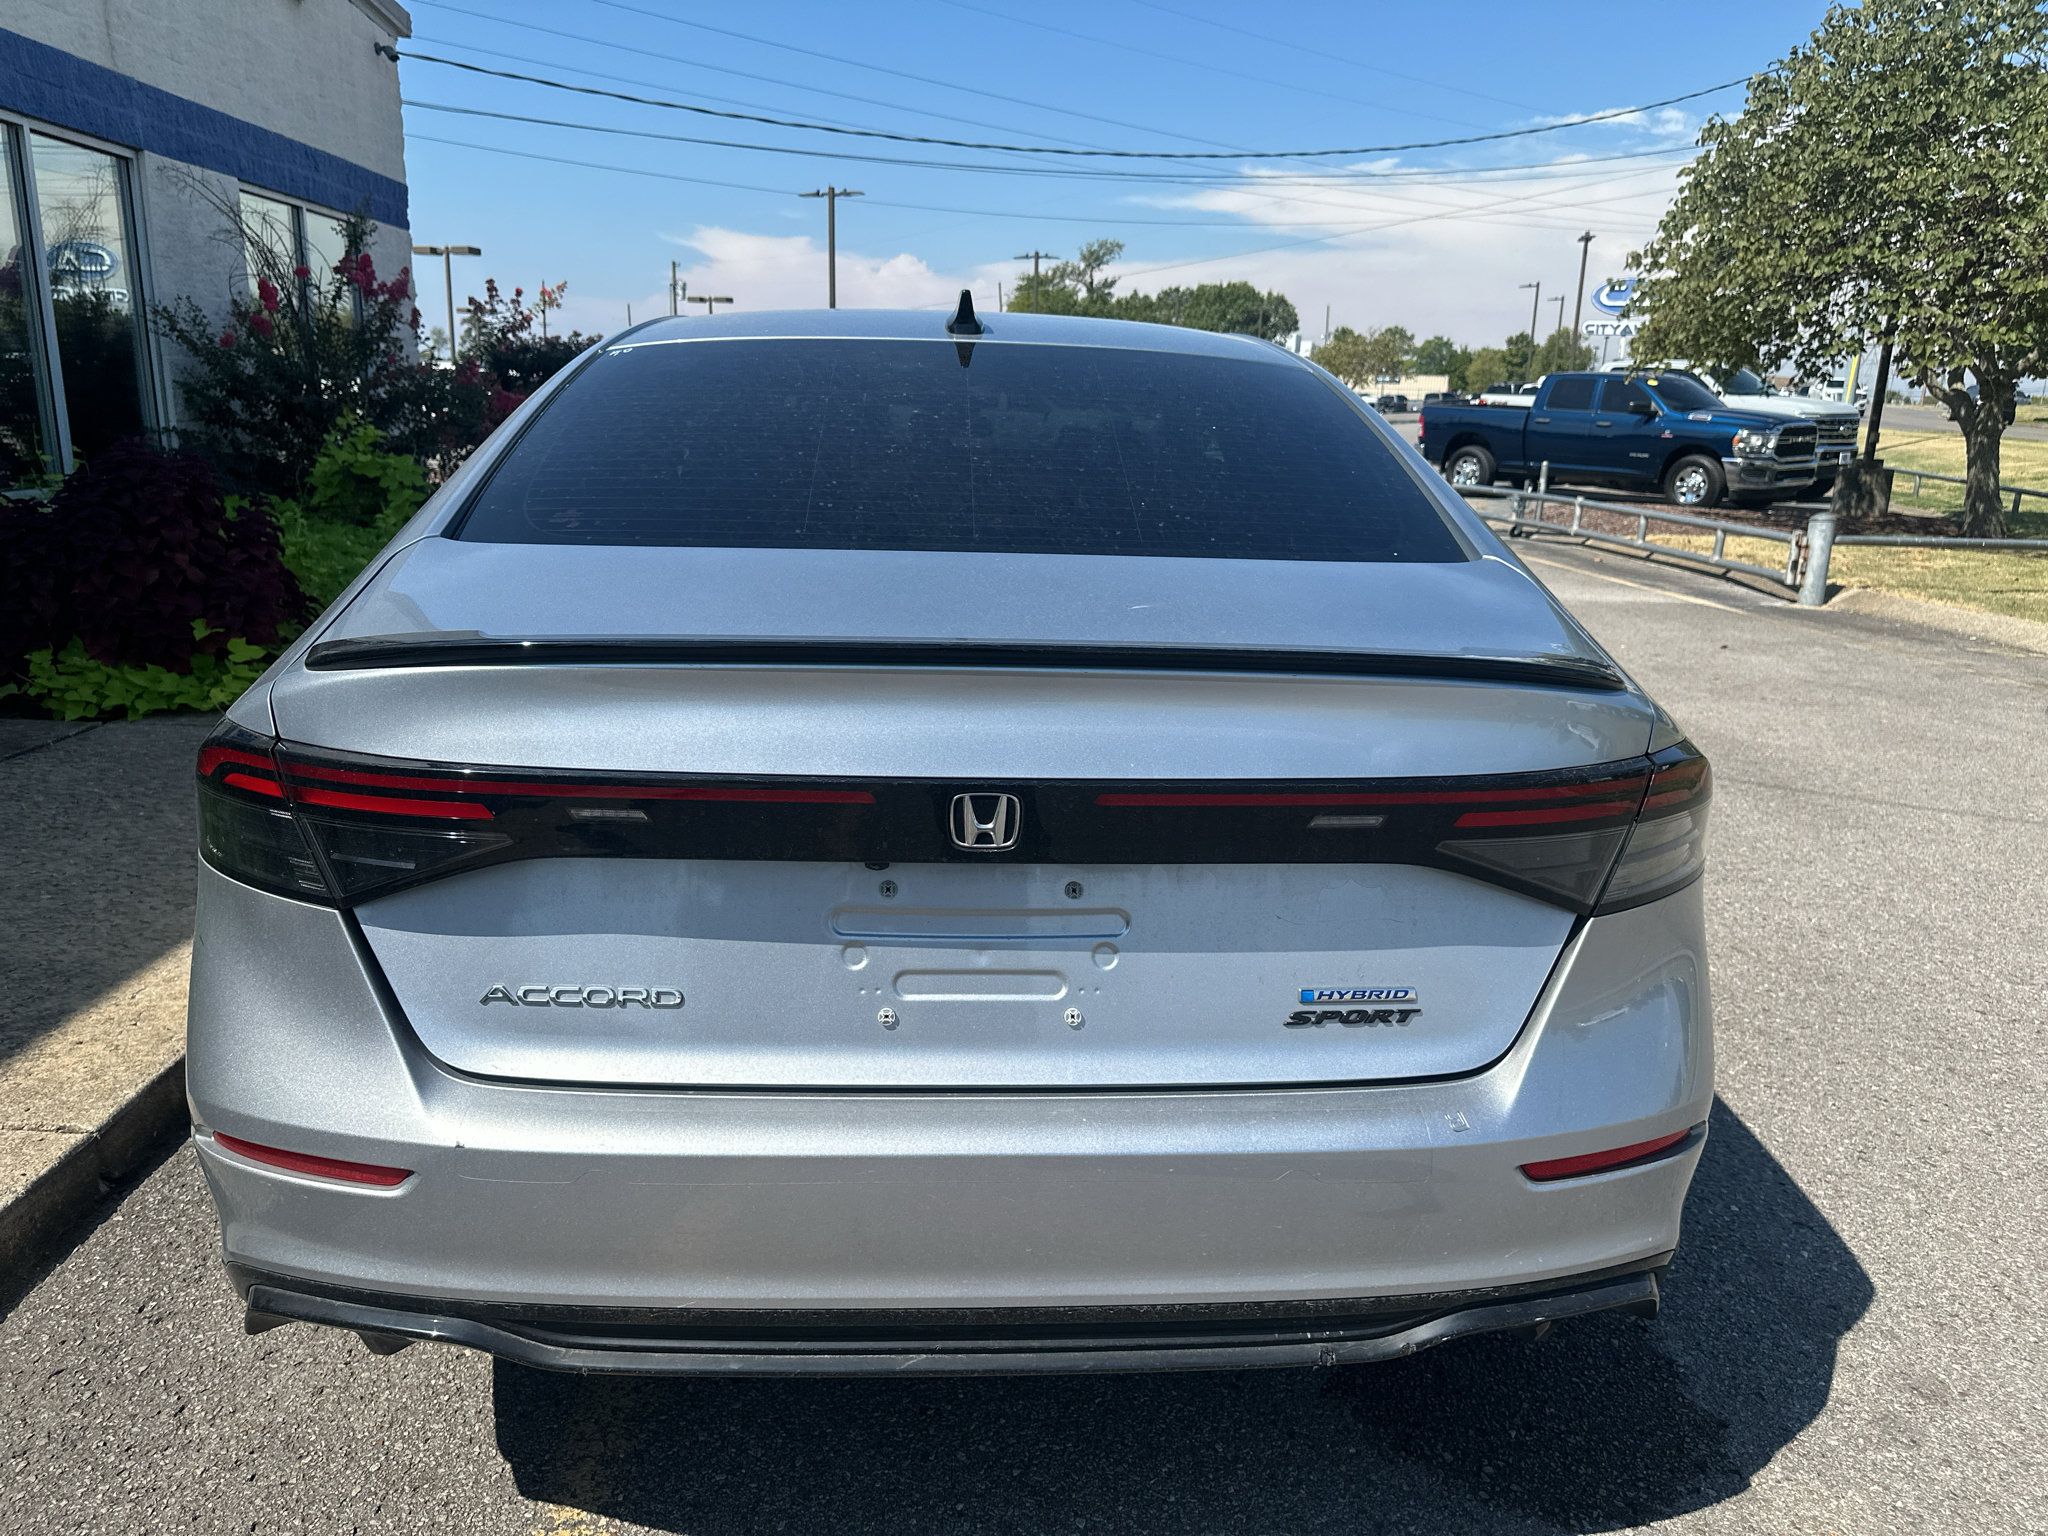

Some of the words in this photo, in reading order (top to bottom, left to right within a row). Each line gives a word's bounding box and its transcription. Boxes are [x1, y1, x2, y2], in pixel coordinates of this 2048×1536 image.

[478, 983, 686, 1009] ACCORD
[1316, 989, 1410, 1001] HYBRID
[1283, 1008, 1423, 1027] SPORT
